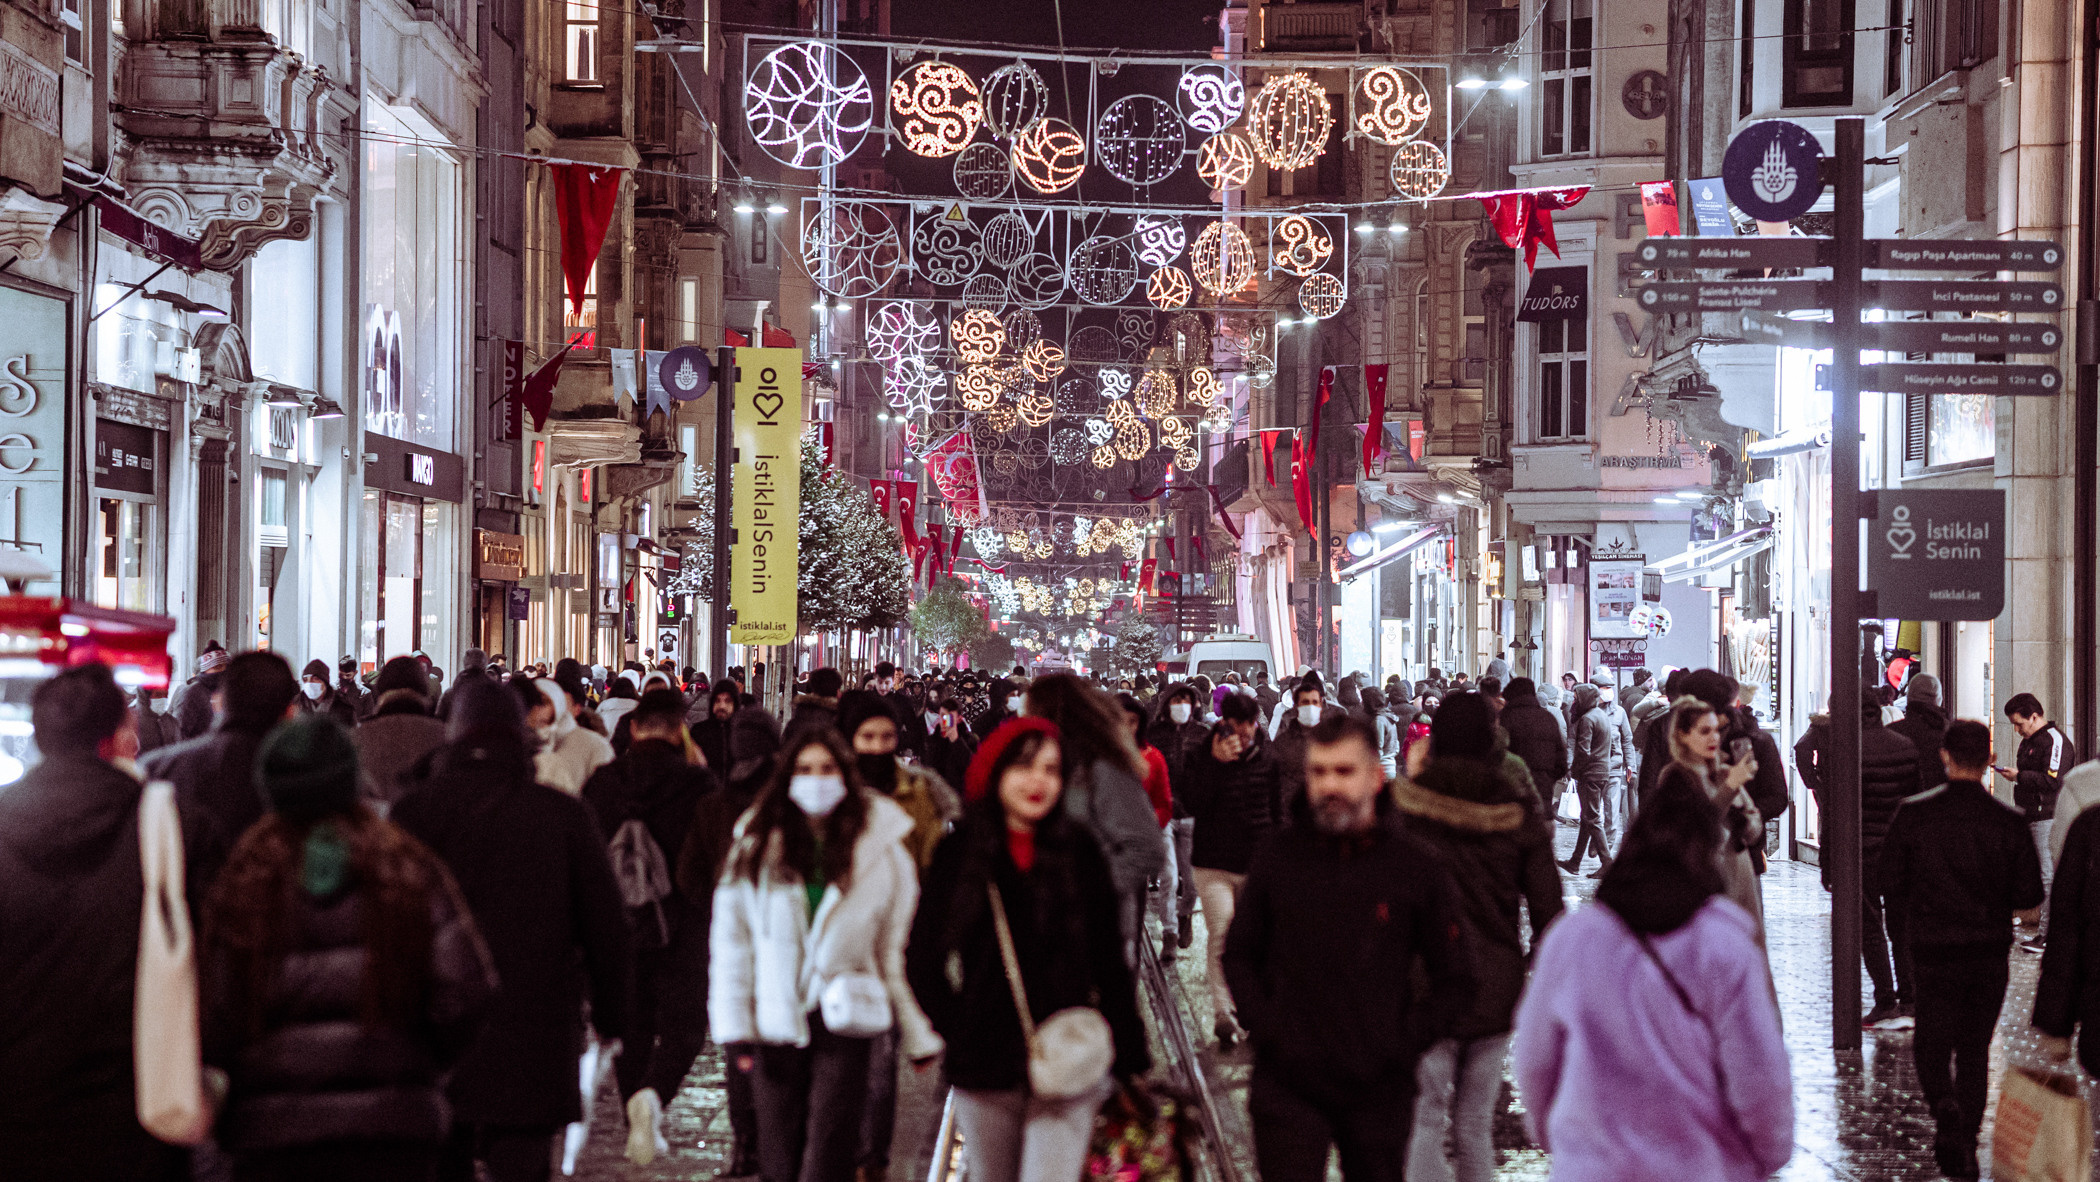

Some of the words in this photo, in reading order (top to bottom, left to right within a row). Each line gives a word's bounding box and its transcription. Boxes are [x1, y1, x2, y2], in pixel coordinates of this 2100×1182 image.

[2010, 251, 2023, 260] 40
[1523, 295, 1580, 311] TUDORS
[2010, 292, 2022, 301] 50
[1941, 332, 1976, 343] Rumeli
[1978, 333, 1999, 343] Han
[2009, 334, 2021, 342] 80
[1904, 374, 1945, 386] Hüseyin
[2009, 376, 2025, 385] 120
[2027, 377, 2037, 385] m
[412, 452, 434, 487] MANGO
[1600, 455, 1681, 471] ARAŞTIRMA
[1927, 518, 1989, 540] İstiklal
[1926, 541, 1981, 559] Senin
[1928, 589, 1981, 600] istiklal.ist
[666, 591, 676, 618] KIDS
[740, 620, 787, 631] istiklal.ist
